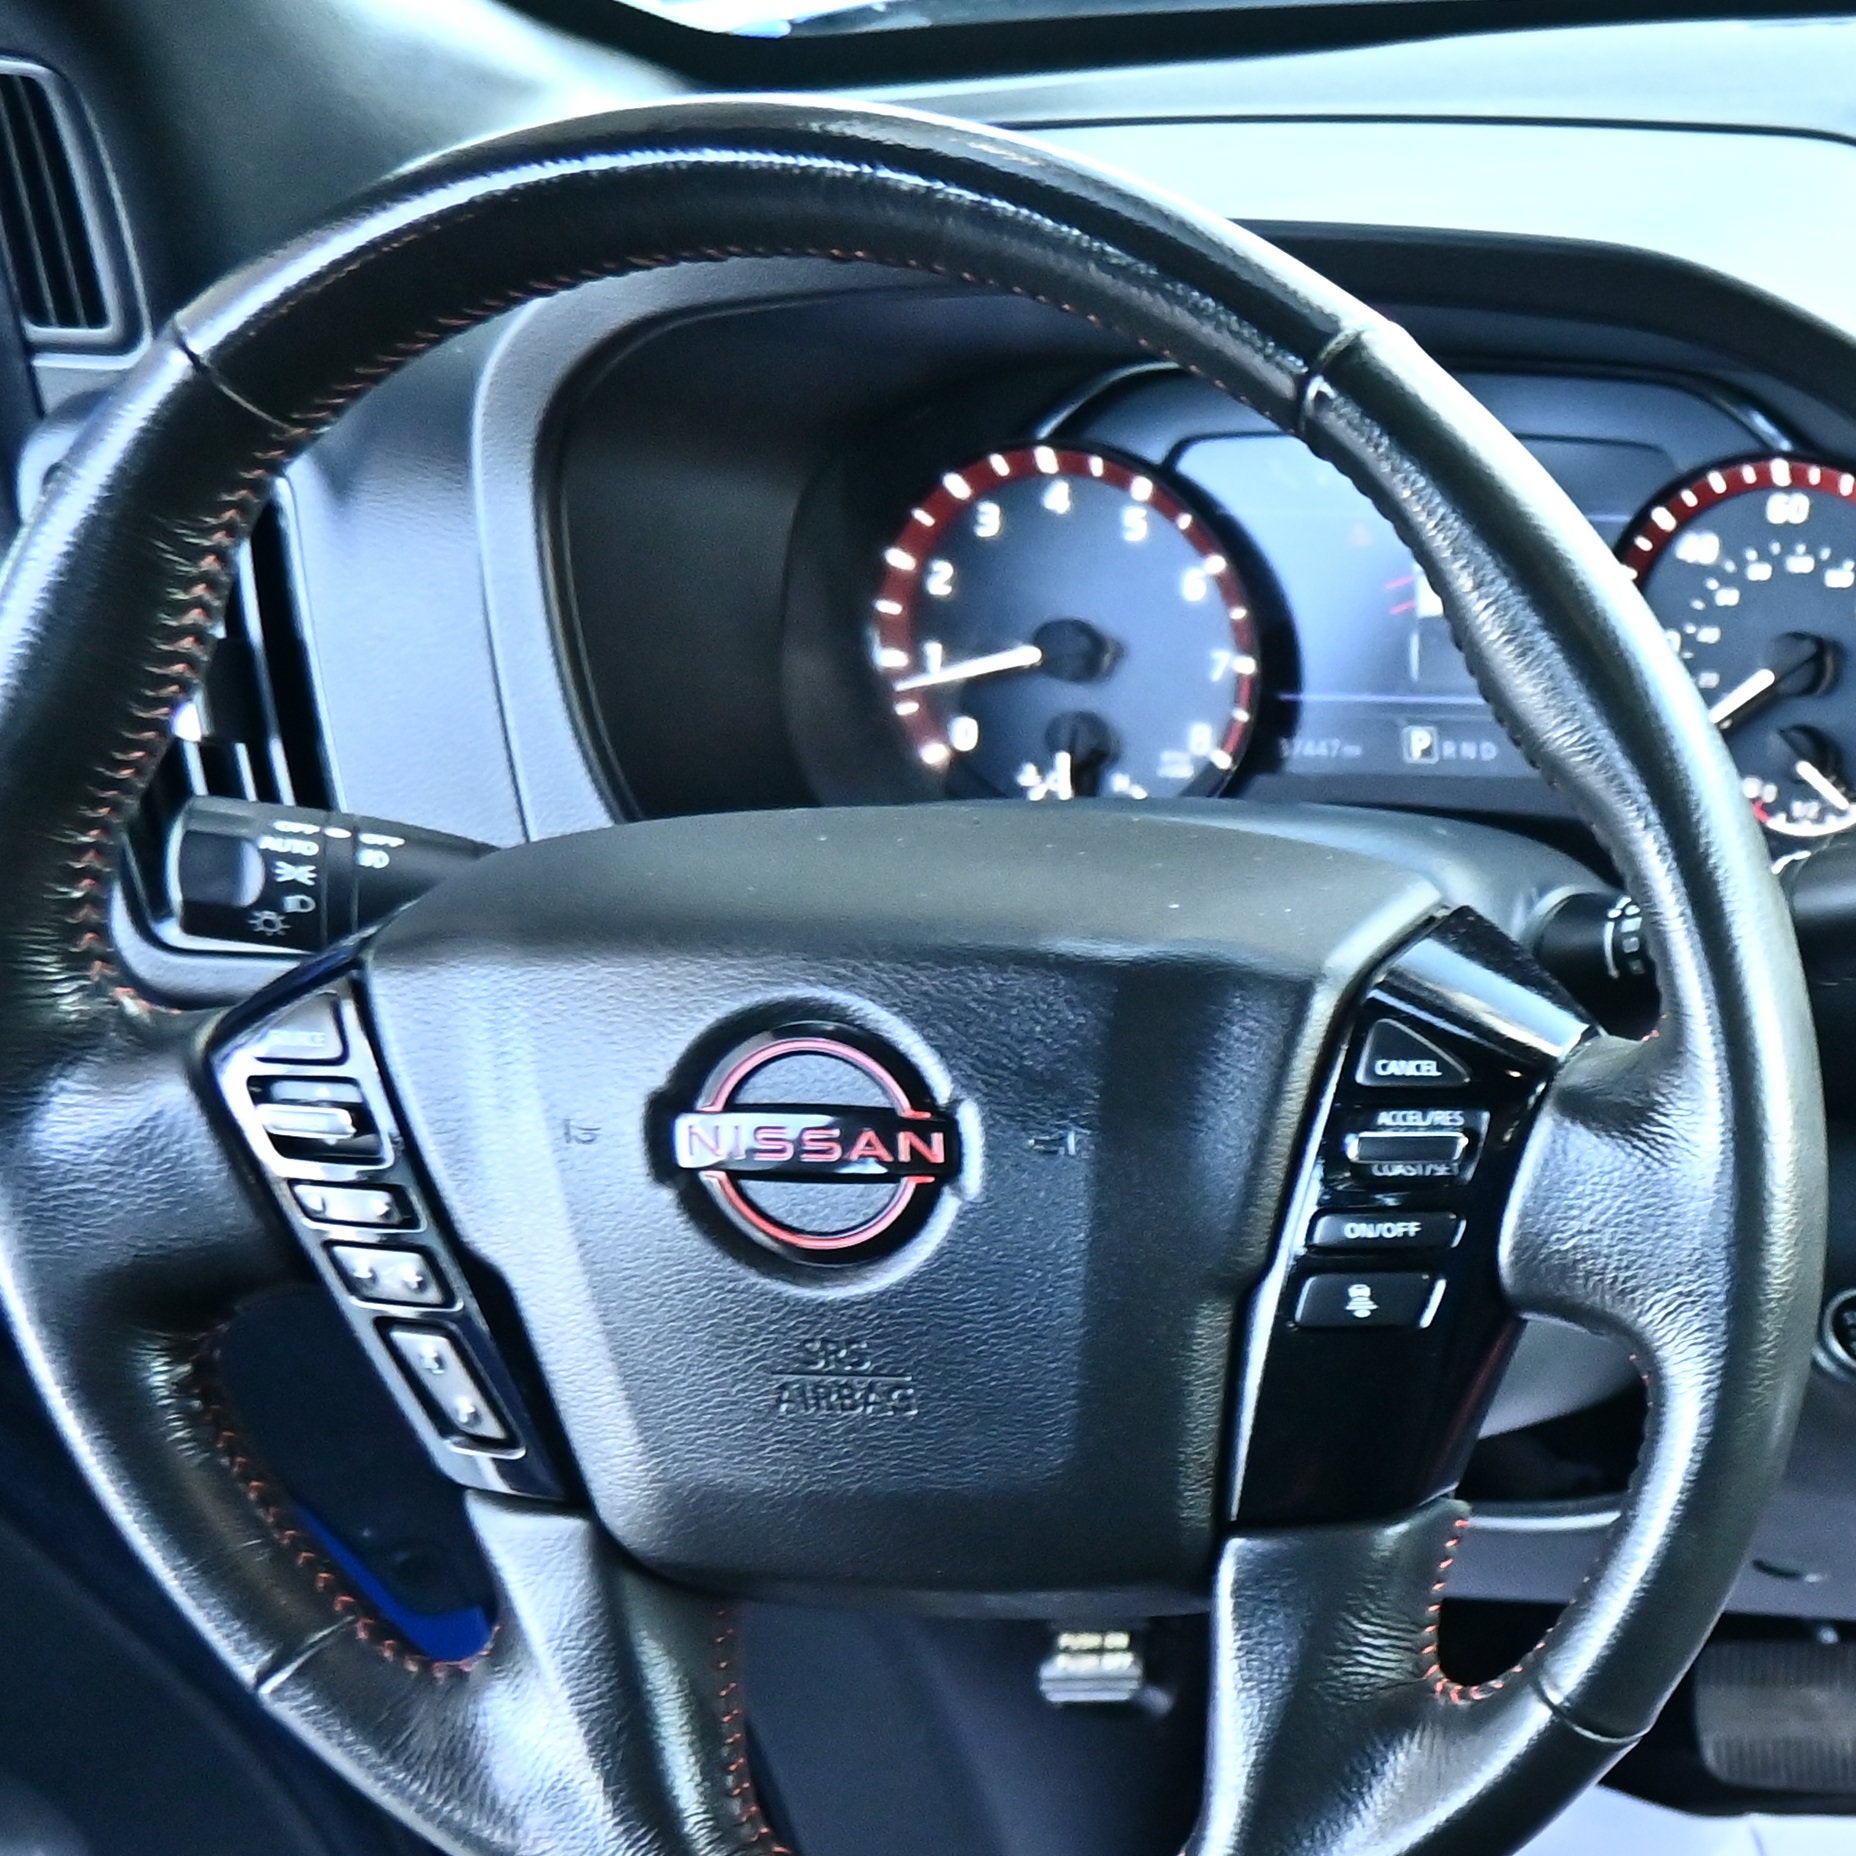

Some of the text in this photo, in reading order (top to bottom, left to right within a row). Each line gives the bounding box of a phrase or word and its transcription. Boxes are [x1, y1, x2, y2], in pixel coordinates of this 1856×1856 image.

[1042, 480, 1071, 514] 4
[973, 502, 1001, 538] 3
[1122, 506, 1149, 543] 5
[926, 559, 954, 596] 2
[1210, 650, 1234, 682] 7
[1410, 728, 1433, 760] P
[1374, 1059, 1443, 1077] CANCEL
[1376, 1110, 1465, 1127] ACCEL/RES
[688, 1126, 946, 1165] NISSAN
[1343, 1222, 1423, 1239] ON/OFF
[775, 1381, 919, 1416] AIRBAG
